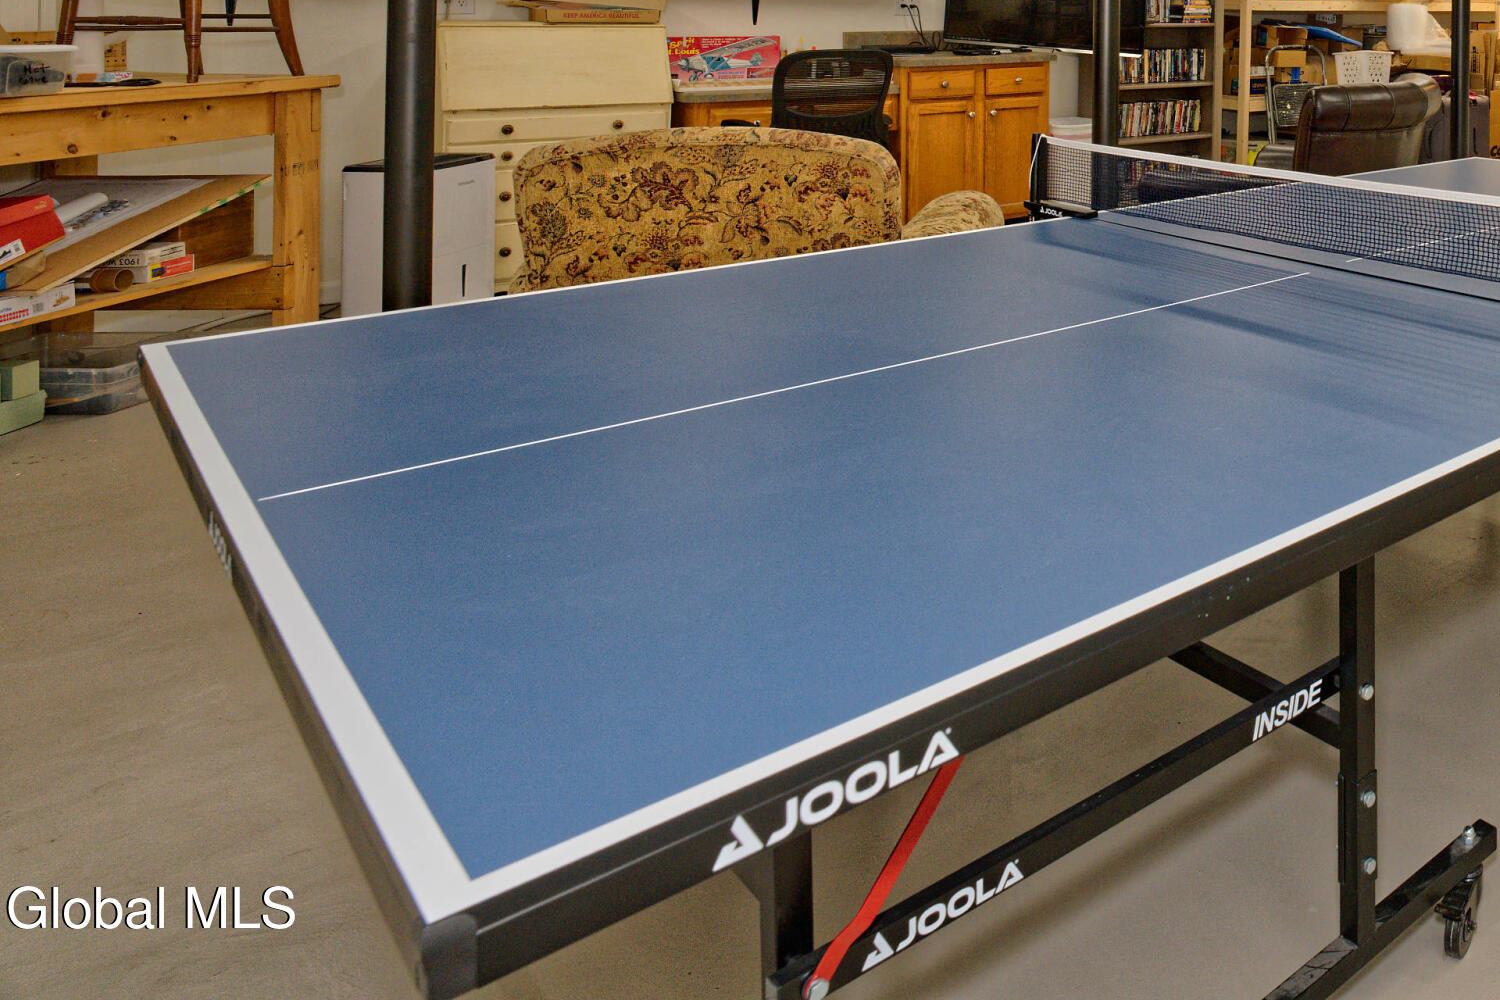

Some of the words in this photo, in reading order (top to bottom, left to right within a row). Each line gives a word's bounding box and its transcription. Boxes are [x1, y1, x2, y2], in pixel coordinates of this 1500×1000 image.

[24, 63, 50, 74] Hot
[1252, 678, 1323, 742] INSIDE
[765, 728, 960, 848] JOOLA
[895, 859, 1025, 953] JOOLA
